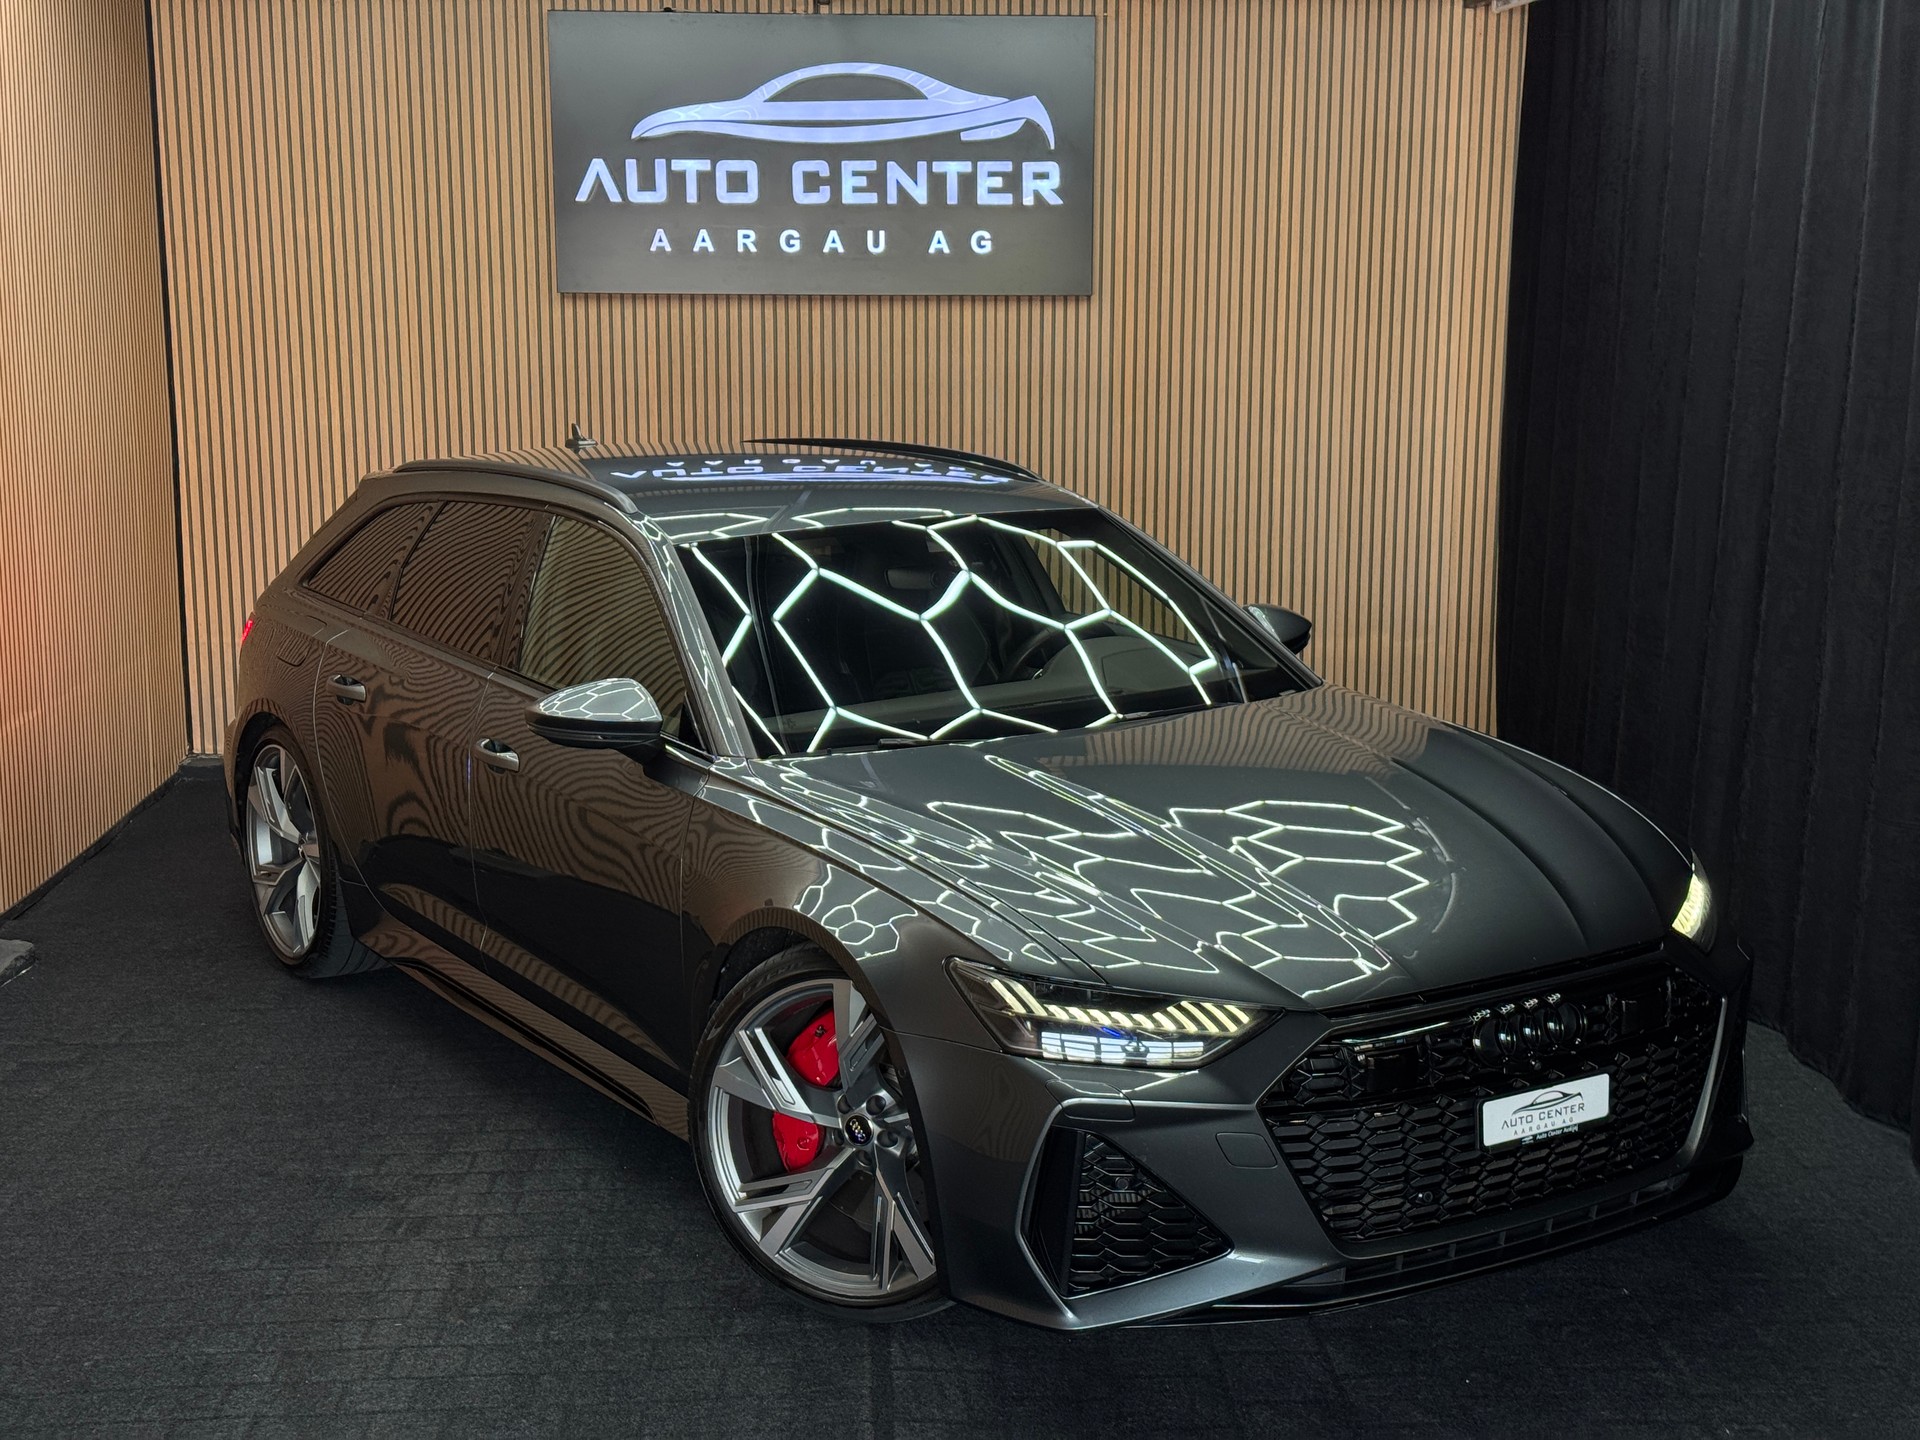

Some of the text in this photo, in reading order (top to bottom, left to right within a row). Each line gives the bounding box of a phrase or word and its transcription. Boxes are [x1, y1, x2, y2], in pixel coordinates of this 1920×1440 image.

[575, 158, 1064, 206] AUTO CENTER
[650, 228, 993, 255] AARGAU AG
[1502, 1103, 1585, 1130] AUTO CENTER
[1514, 1121, 1555, 1136] AARGAU
